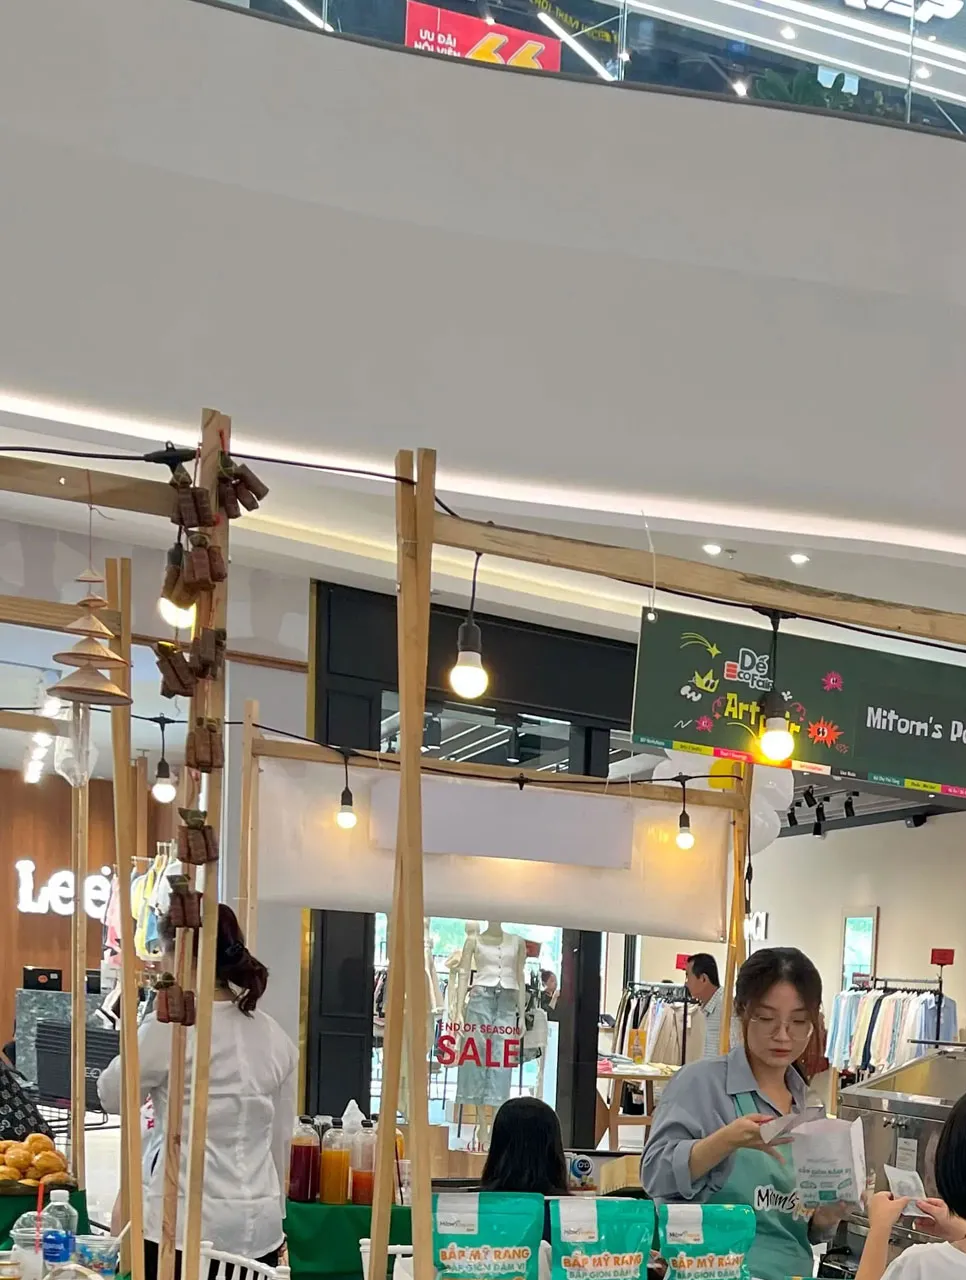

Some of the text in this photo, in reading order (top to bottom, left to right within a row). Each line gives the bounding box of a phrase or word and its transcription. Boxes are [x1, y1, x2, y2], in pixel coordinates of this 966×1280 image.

[724, 692, 760, 726] Art
[866, 706, 943, 740] Mitom's
[14, 859, 111, 920] Lee
[438, 1021, 522, 1036] END OF SEASON
[436, 1034, 521, 1069] SALE
[494, 1248, 530, 1261] RANG
